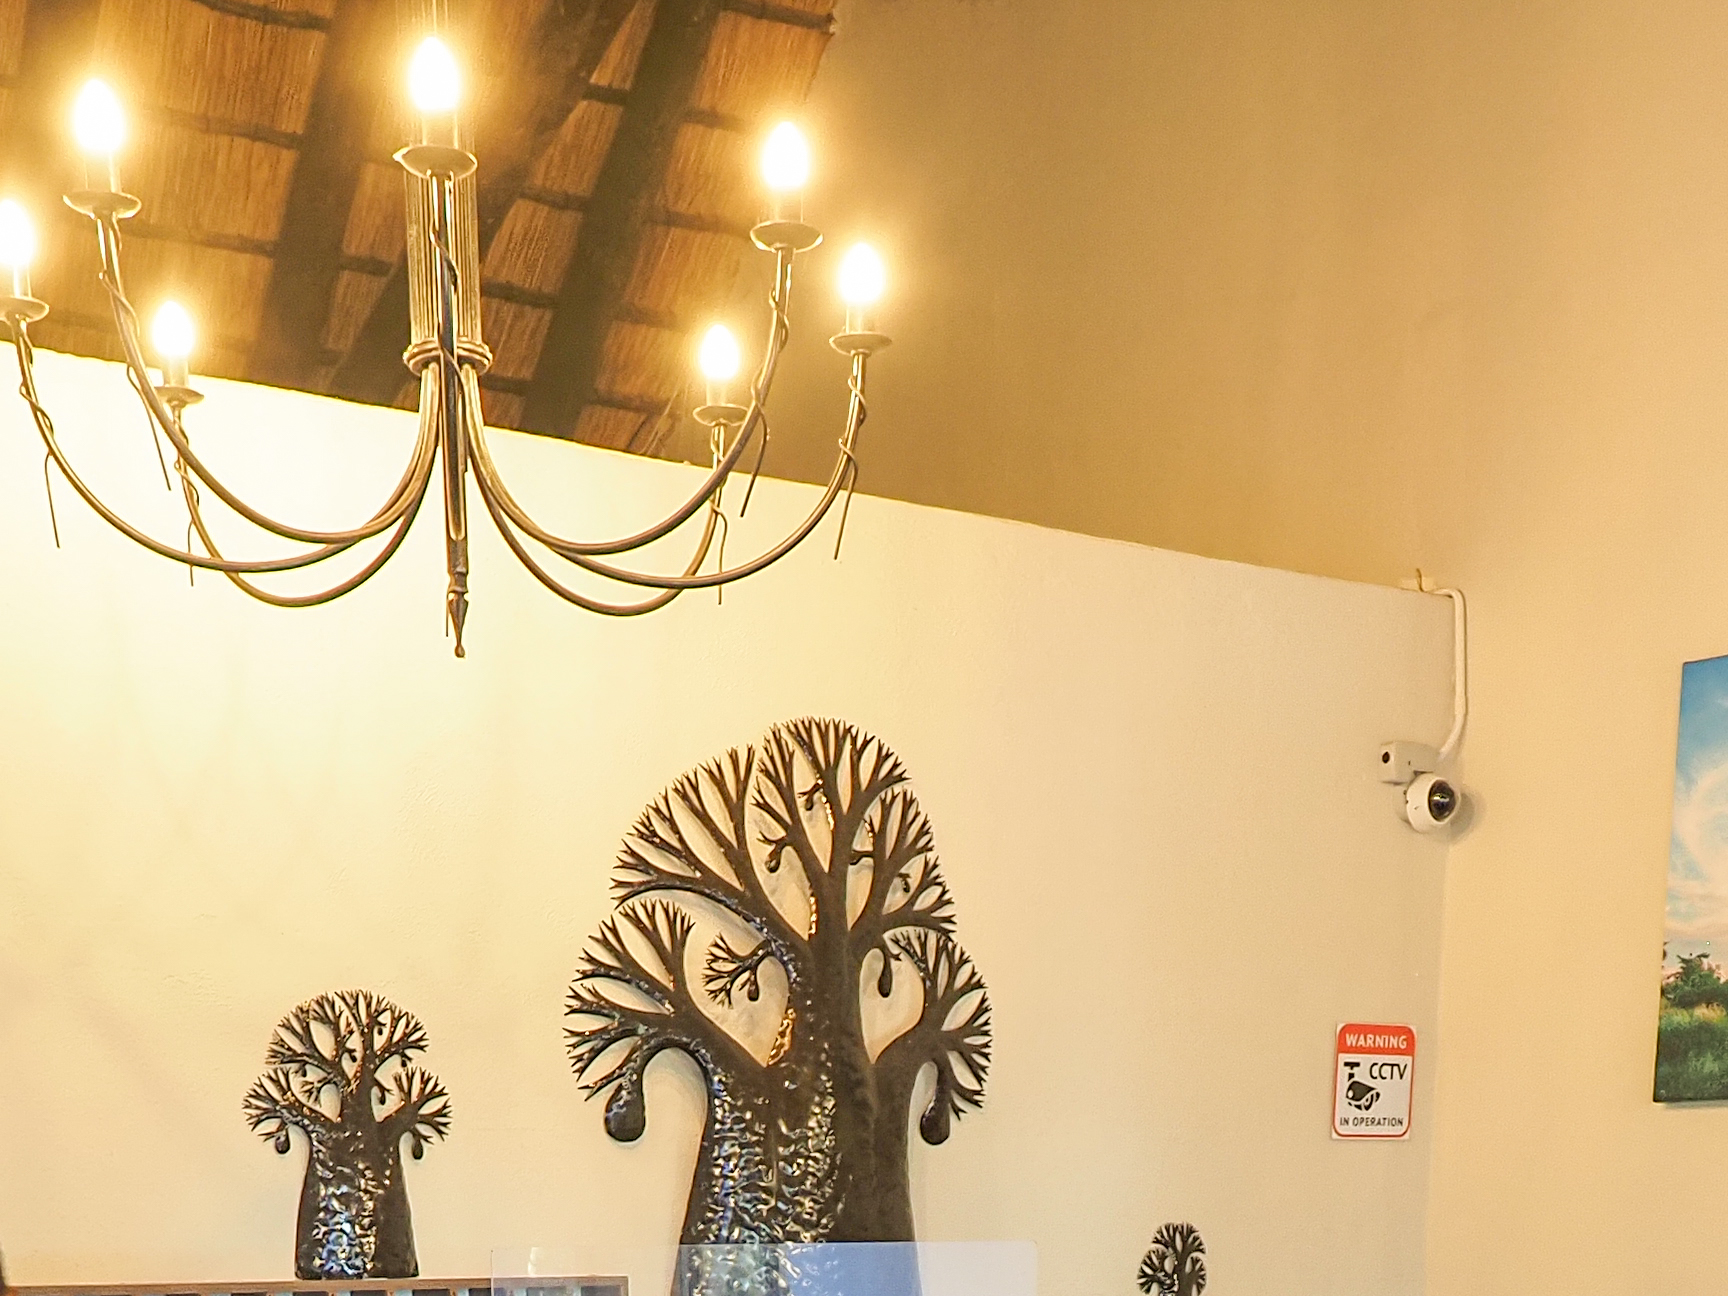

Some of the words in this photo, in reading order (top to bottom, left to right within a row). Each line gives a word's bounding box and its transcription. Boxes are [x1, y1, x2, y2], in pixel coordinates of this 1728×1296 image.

[1345, 1033, 1407, 1049] WARNING
[1369, 1062, 1408, 1080] CCTV
[1340, 1117, 1350, 1126] IN
[1352, 1117, 1404, 1127] OPERATION
